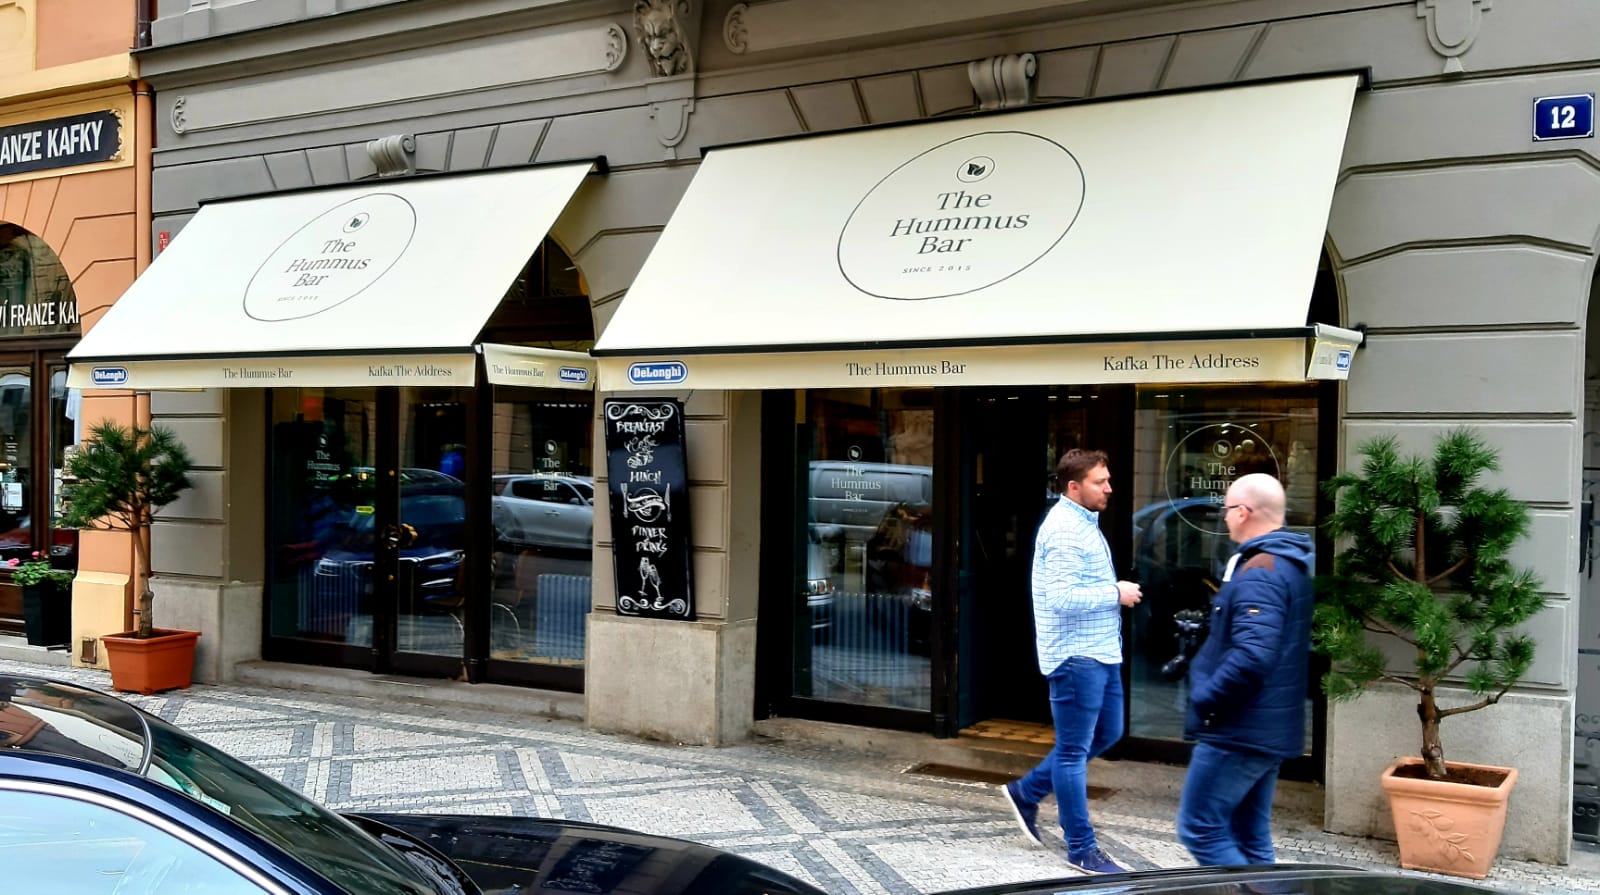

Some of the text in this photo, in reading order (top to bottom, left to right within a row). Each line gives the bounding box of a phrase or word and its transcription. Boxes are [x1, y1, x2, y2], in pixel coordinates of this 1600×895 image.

[1551, 105, 1576, 129] 12
[0, 119, 103, 166] ANZE KAFKY
[936, 190, 993, 211] The
[888, 214, 1031, 237] Hummus
[321, 239, 357, 254] The
[916, 236, 973, 255] Bar
[285, 258, 372, 274] Hummus
[901, 266, 932, 274] SINCE
[292, 273, 329, 288] Bar
[11, 302, 55, 327] FRANZE
[846, 360, 967, 376] The Hummus Bar
[1103, 353, 1260, 371] Kafka The Address
[222, 368, 293, 379] The Hummus Bar
[368, 364, 453, 377] Kafka The Address
[633, 366, 682, 380] DeLonghi
[542, 457, 560, 468] The
[1207, 462, 1236, 476] The
[844, 464, 865, 477] The
[543, 480, 561, 491] Bar
[831, 477, 882, 490] Hummus
[845, 490, 865, 501] Bar
